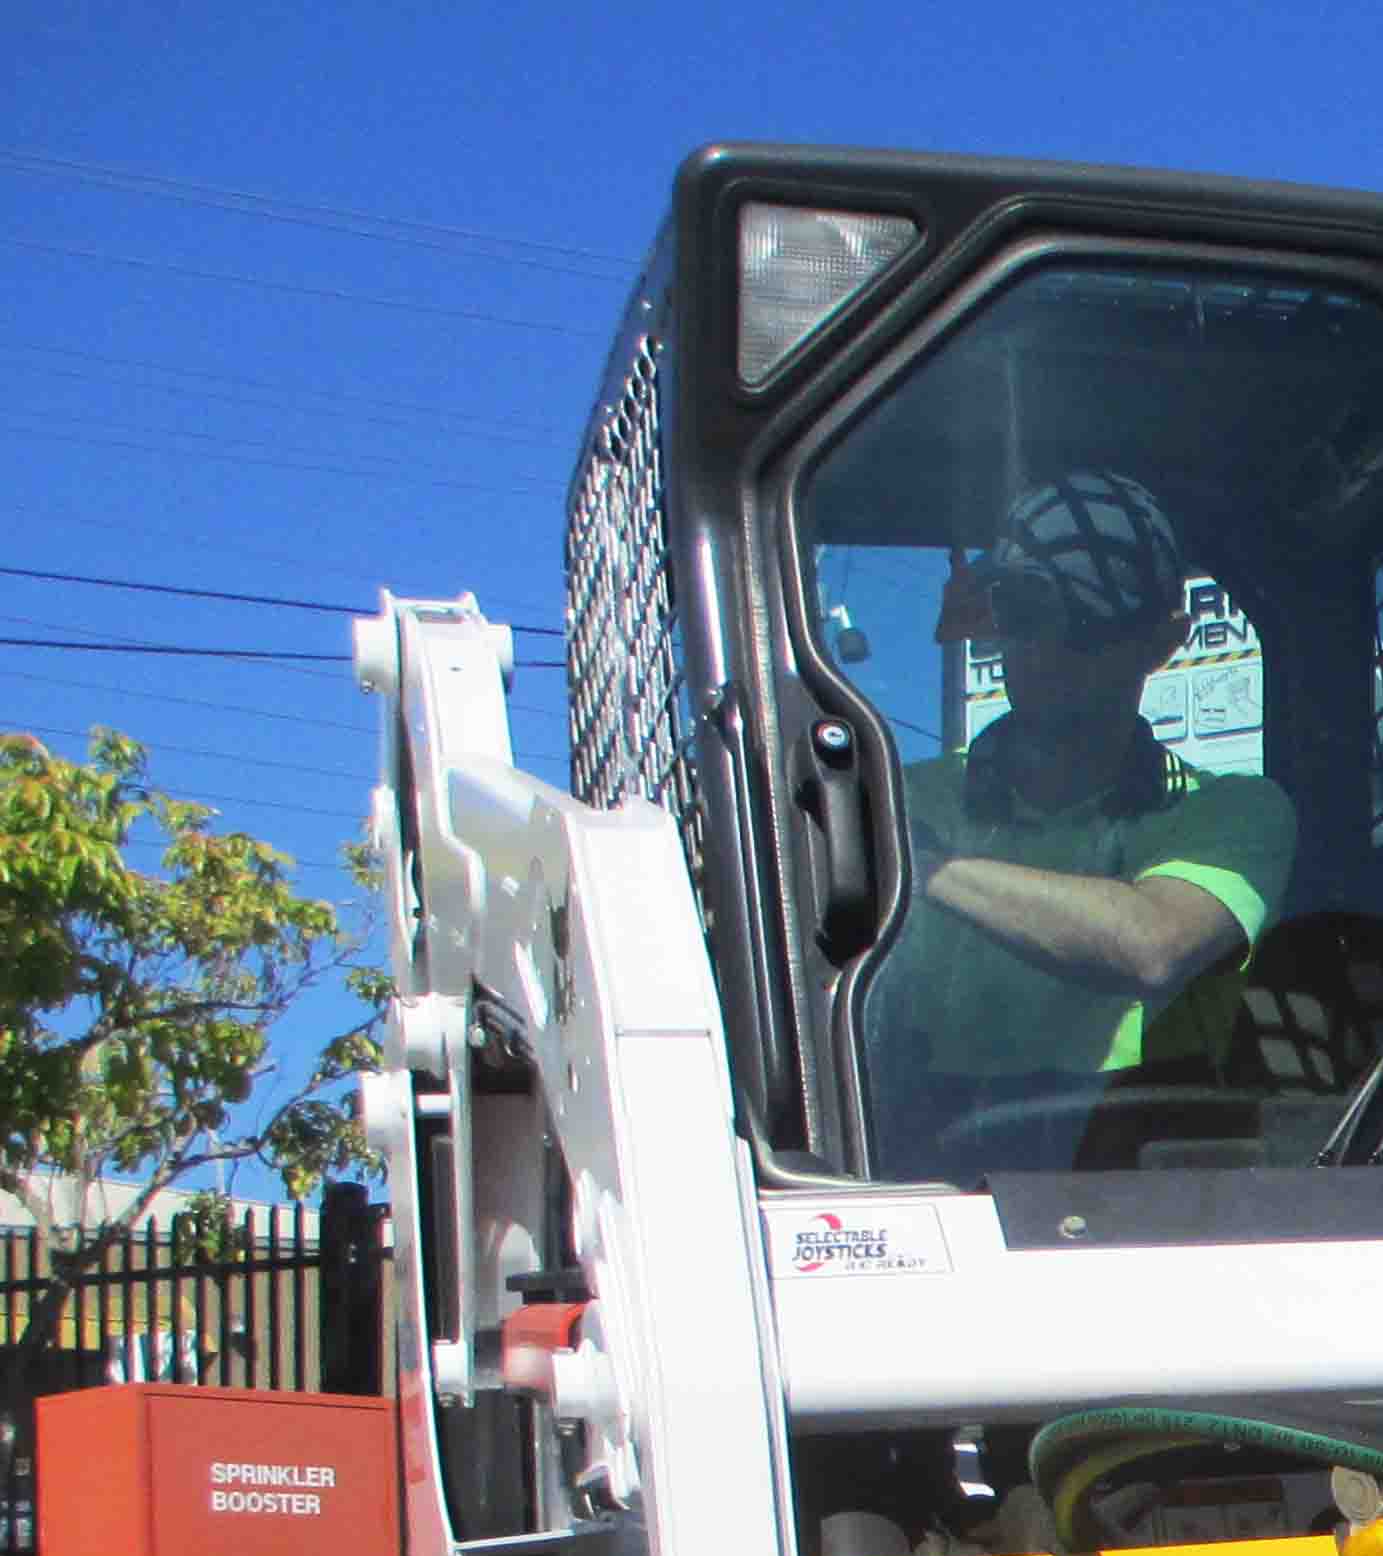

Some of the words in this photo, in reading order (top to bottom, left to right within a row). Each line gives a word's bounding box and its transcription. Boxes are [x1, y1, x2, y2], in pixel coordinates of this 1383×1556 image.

[796, 1229, 888, 1245] SELECTABLE
[792, 1243, 888, 1262] JOYSTICKS
[211, 1461, 337, 1487] SPRINKLER
[211, 1491, 321, 1515] BOOSTER
